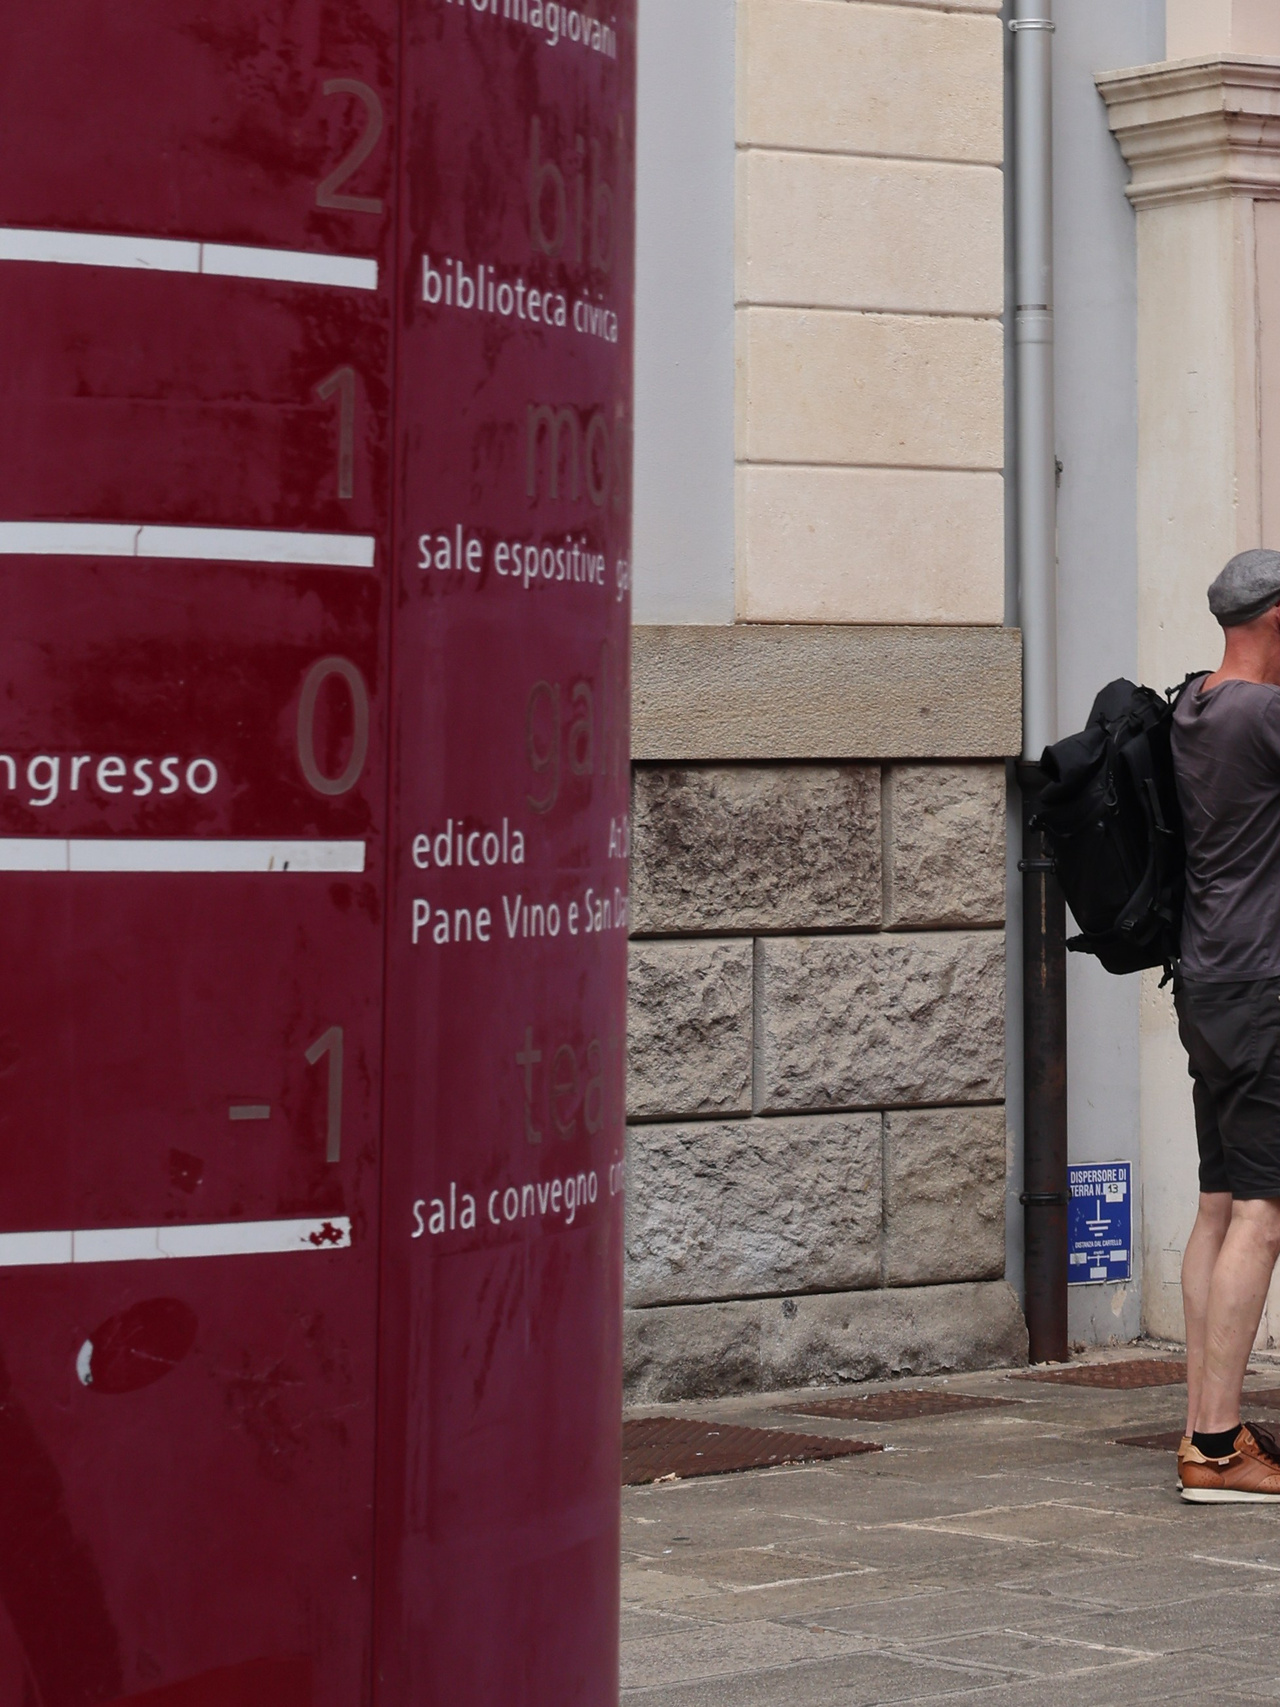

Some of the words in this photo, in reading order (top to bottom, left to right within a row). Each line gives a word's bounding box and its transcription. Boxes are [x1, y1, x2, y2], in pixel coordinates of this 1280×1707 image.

[316, 78, 383, 214] 2
[422, 255, 567, 327] biblioteca
[573, 288, 618, 343] civica
[317, 367, 355, 499] 1
[418, 524, 483, 573] sale
[494, 535, 605, 590] espositive
[298, 656, 369, 796] 0
[412, 817, 525, 869] edicola
[412, 899, 491, 944] Pane
[502, 895, 561, 938] Vino
[568, 901, 579, 935] e
[584, 888, 612, 933] San
[411, 1181, 476, 1238] sala
[487, 1170, 598, 1225] convegno
[1070, 1184, 1094, 1197] TERRA
[1071, 1169, 1117, 1183] DISPERSORE
[1119, 1169, 1126, 1180] DI
[1108, 1184, 1118, 1193] 13
